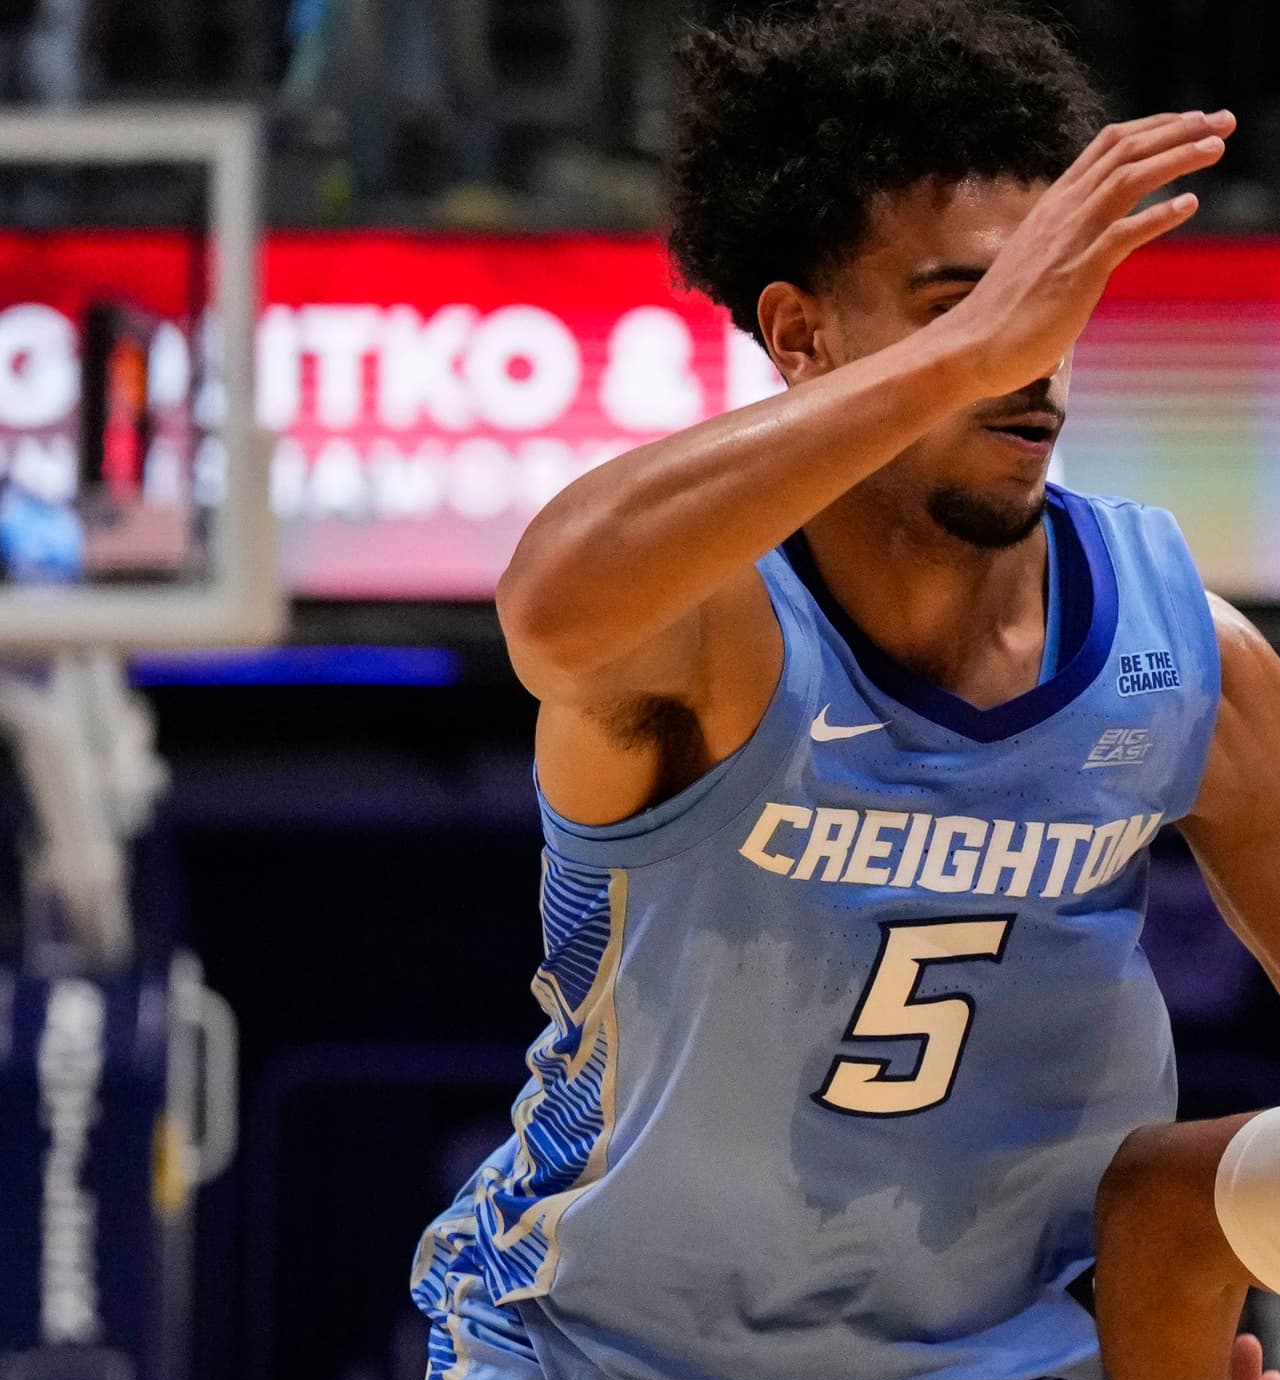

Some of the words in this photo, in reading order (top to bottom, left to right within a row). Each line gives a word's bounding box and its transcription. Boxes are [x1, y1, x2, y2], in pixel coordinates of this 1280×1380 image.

[1120, 654, 1142, 675] BE
[1145, 651, 1172, 670] THE
[1118, 670, 1180, 694] CHANGE
[1098, 728, 1149, 745] BIG
[1087, 743, 1153, 761] EAST
[738, 802, 1164, 898] CREIGHTON
[810, 913, 1018, 1119] 5
